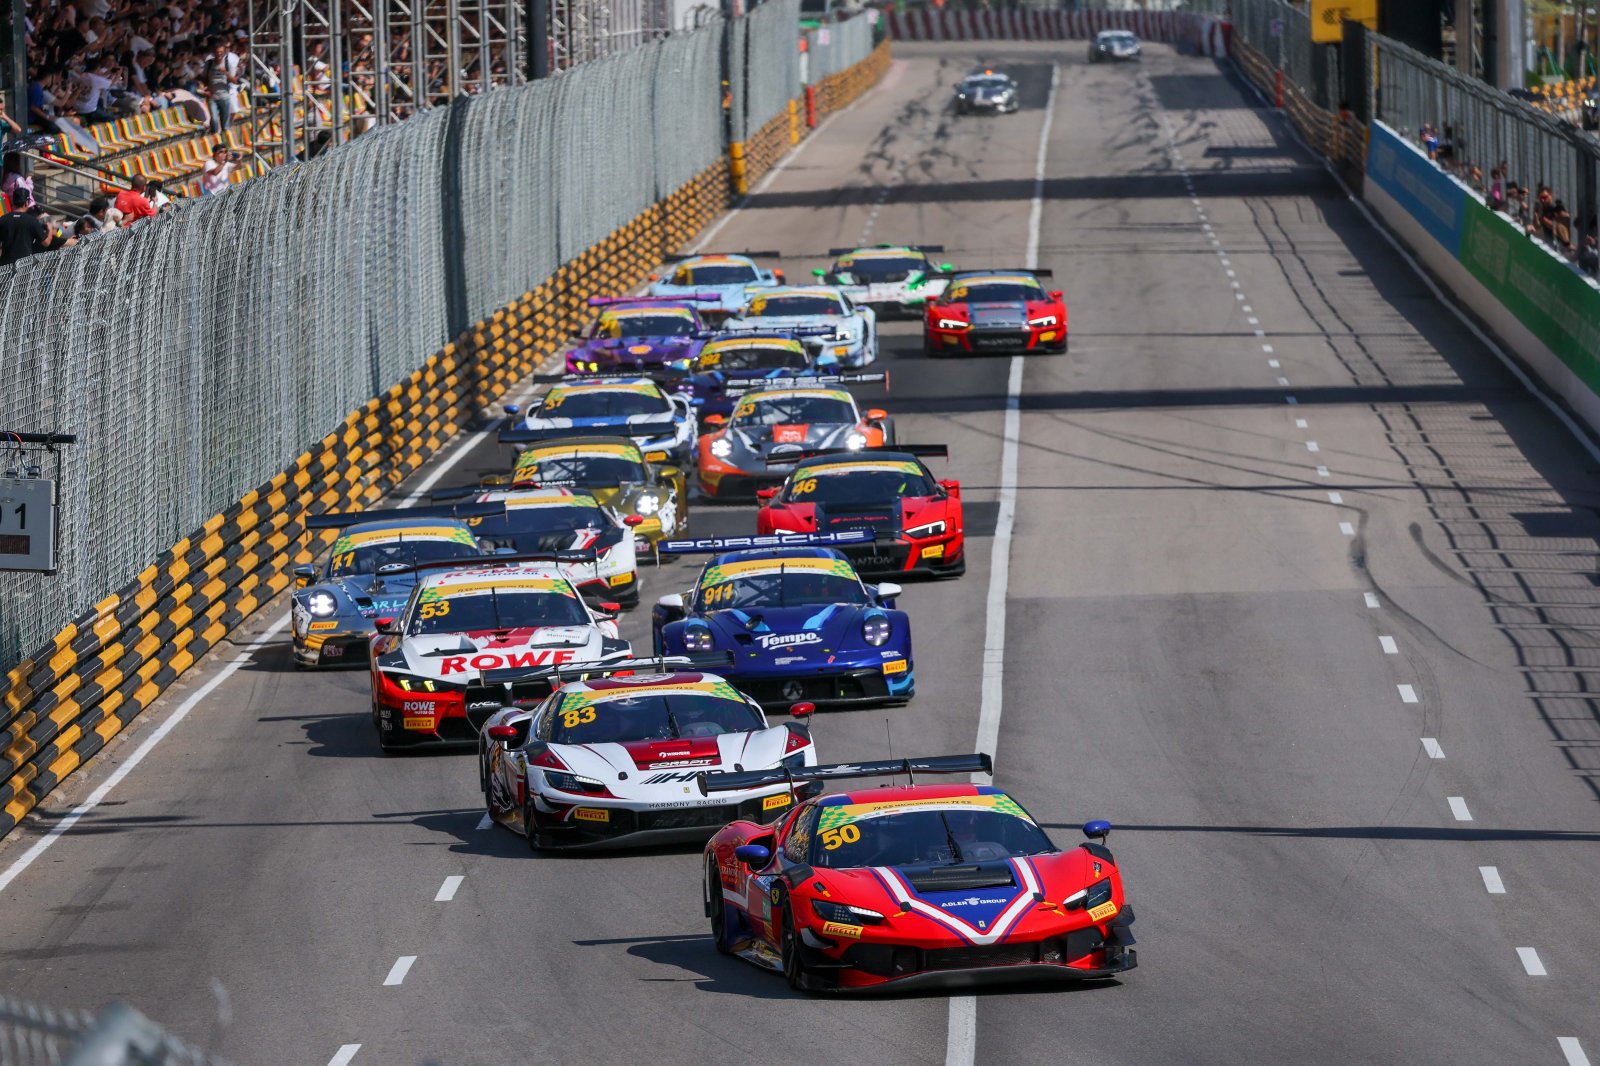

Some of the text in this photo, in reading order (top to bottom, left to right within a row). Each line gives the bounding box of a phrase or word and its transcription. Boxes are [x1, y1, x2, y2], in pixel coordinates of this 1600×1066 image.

[514, 465, 538, 482] 22
[791, 478, 817, 494] 46
[667, 531, 865, 549] PORSCHE
[332, 551, 355, 570] 11
[704, 583, 733, 605] 911
[421, 600, 450, 620] 53
[755, 632, 822, 650] Tempo
[440, 650, 576, 676] ROWE
[404, 701, 435, 711] ROWE
[563, 706, 597, 729] 83
[648, 798, 727, 809] HARMONY RACING
[765, 796, 792, 808] PIRELLI
[821, 823, 861, 851] 50
[1090, 903, 1116, 921] PIRELLI
[824, 922, 859, 937] PIRELLI
